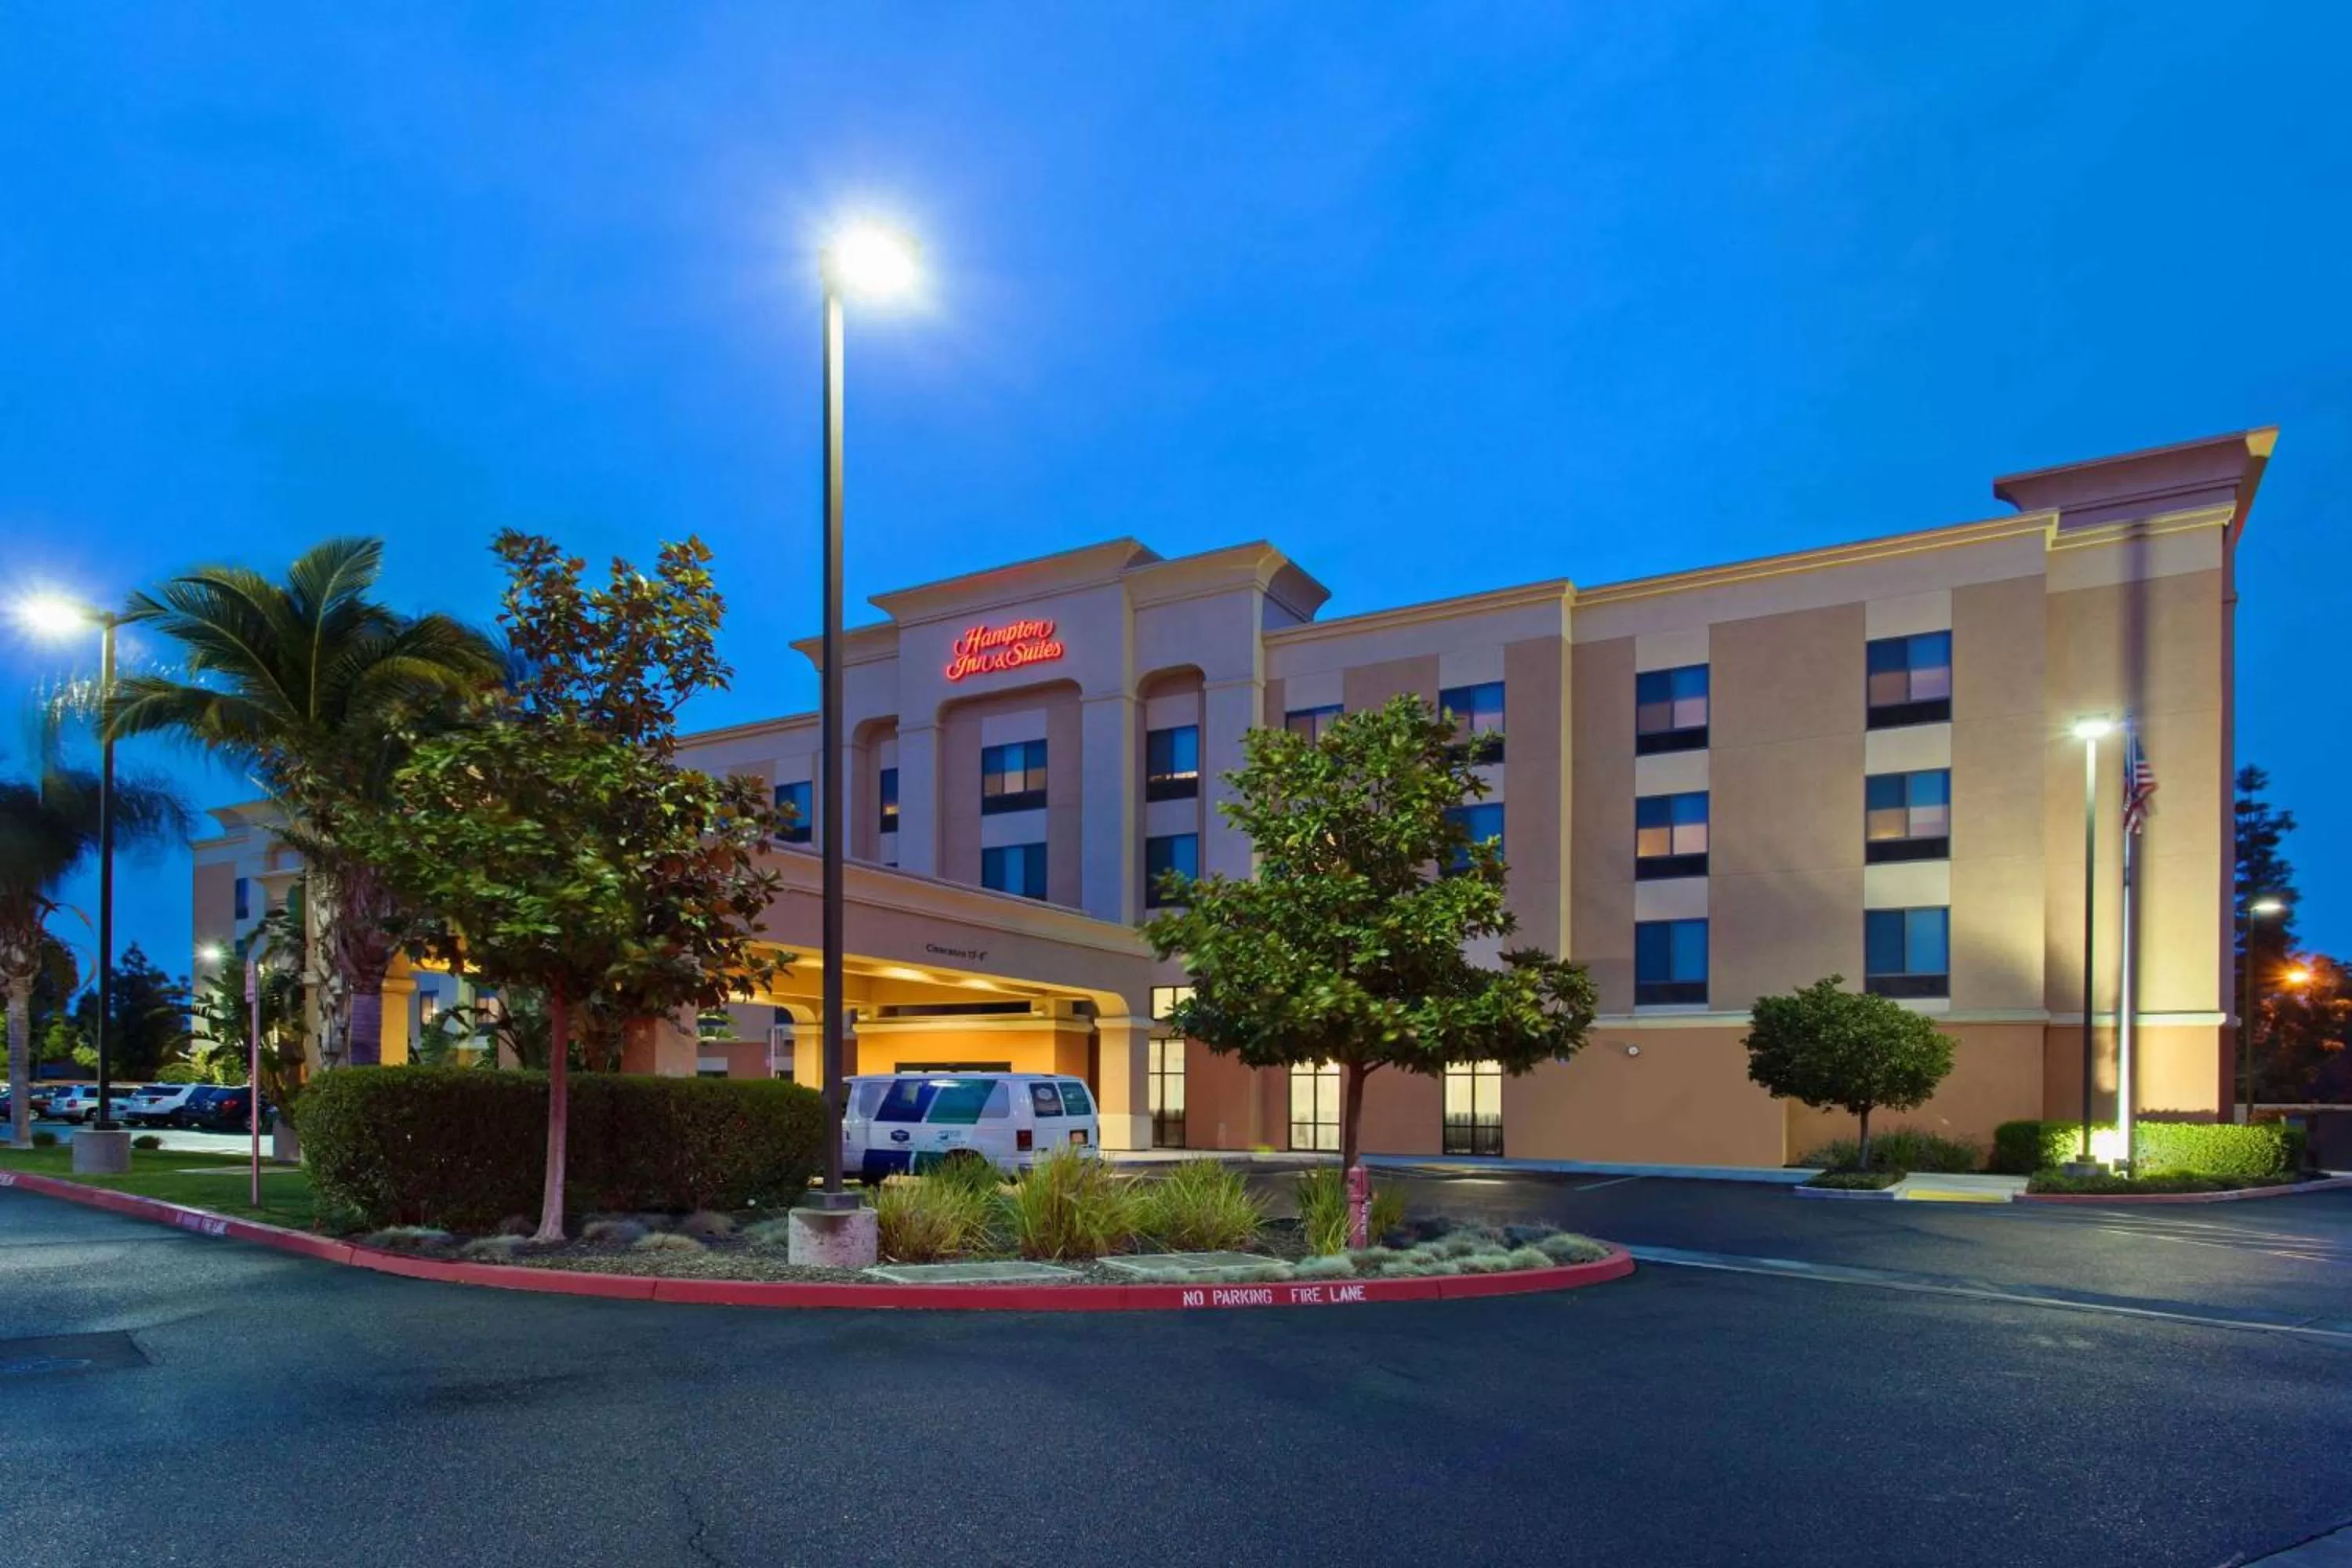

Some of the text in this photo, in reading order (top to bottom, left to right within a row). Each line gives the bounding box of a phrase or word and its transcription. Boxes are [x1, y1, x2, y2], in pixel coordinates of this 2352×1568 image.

[954, 618, 1054, 655] Hampton
[946, 654, 995, 681] Inn
[1006, 639, 1062, 666] Suites
[1182, 1285, 1367, 1307] NO PARKING FIRE LANE
